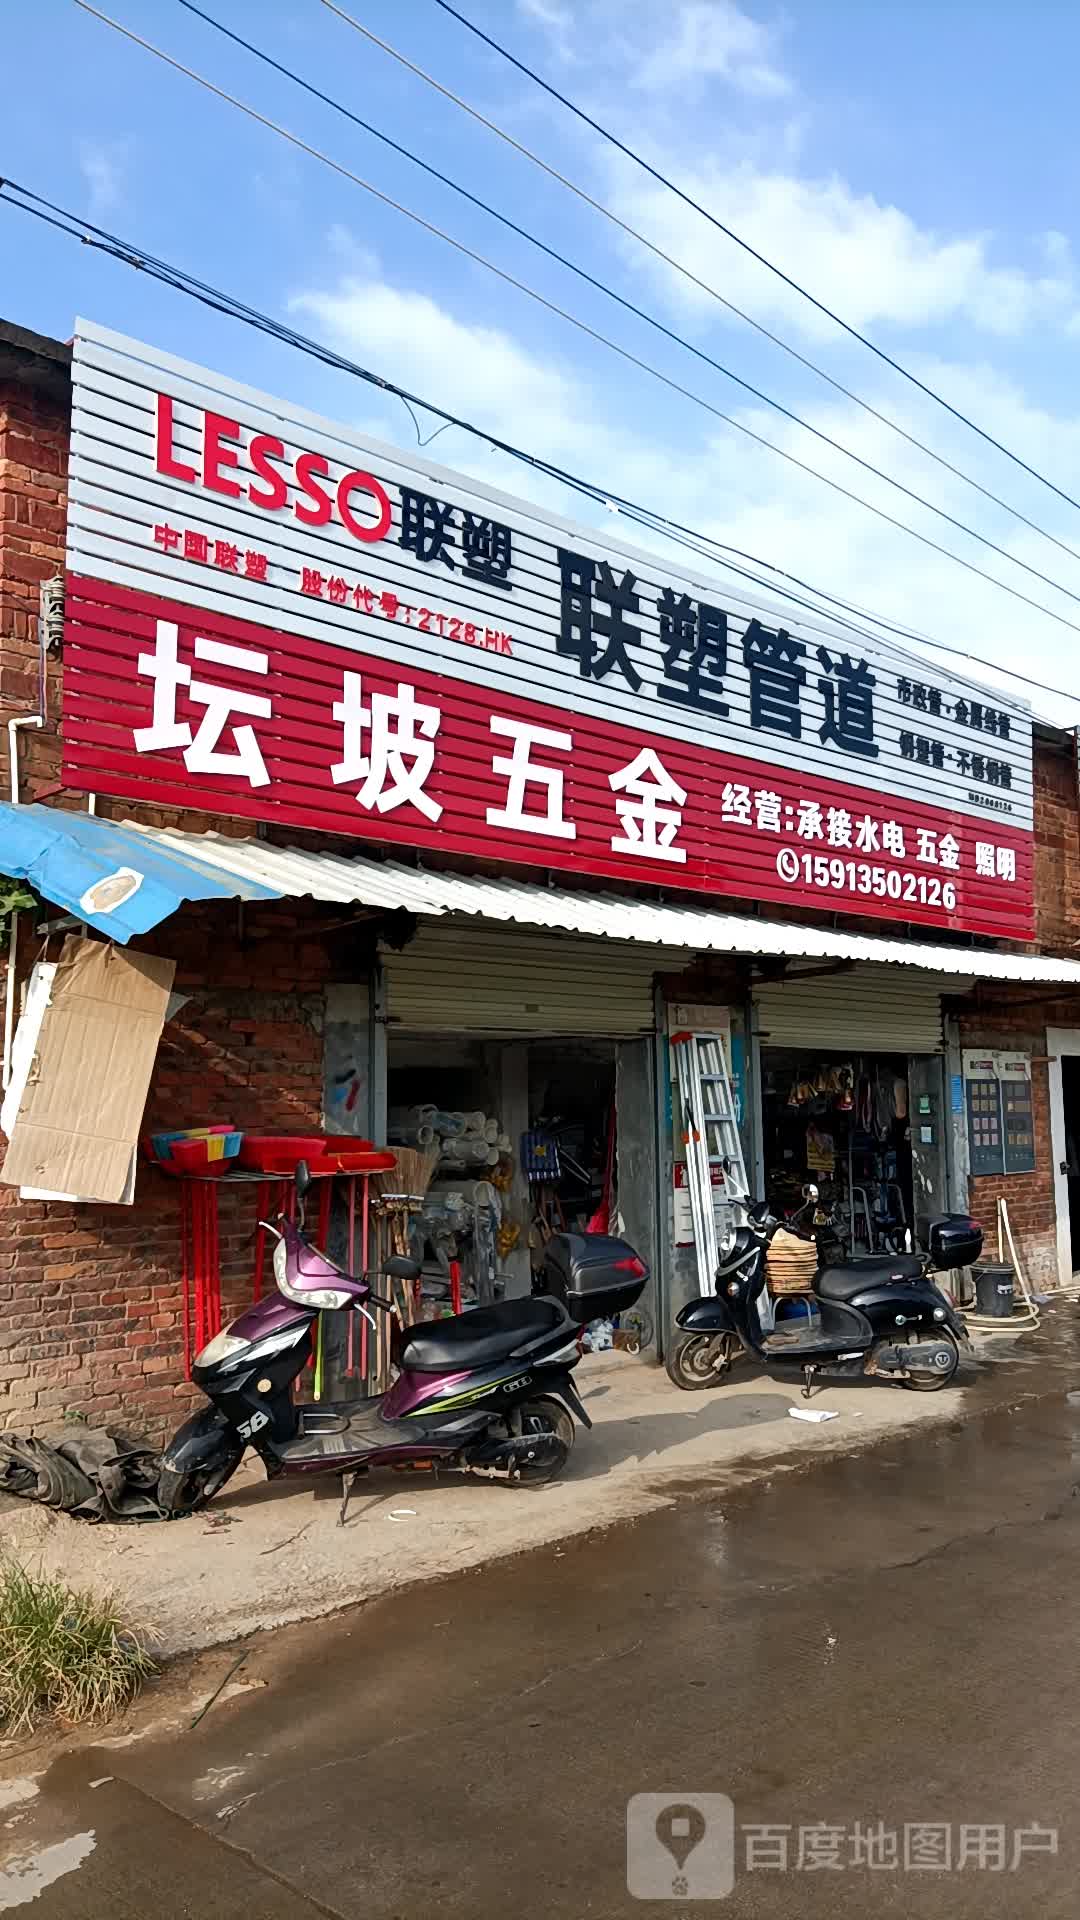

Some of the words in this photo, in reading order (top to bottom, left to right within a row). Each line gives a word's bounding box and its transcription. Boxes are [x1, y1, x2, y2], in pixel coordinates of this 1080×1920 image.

[154, 523, 267, 580] 中国联塑
[155, 393, 392, 543] LESSO
[400, 487, 513, 591] 联塑
[556, 548, 879, 758] 联塑管道
[132, 619, 689, 864] 坛坡五金
[801, 853, 956, 911] 15913502126
[916, 828, 961, 871] 五金
[975, 841, 1016, 882] 照明
